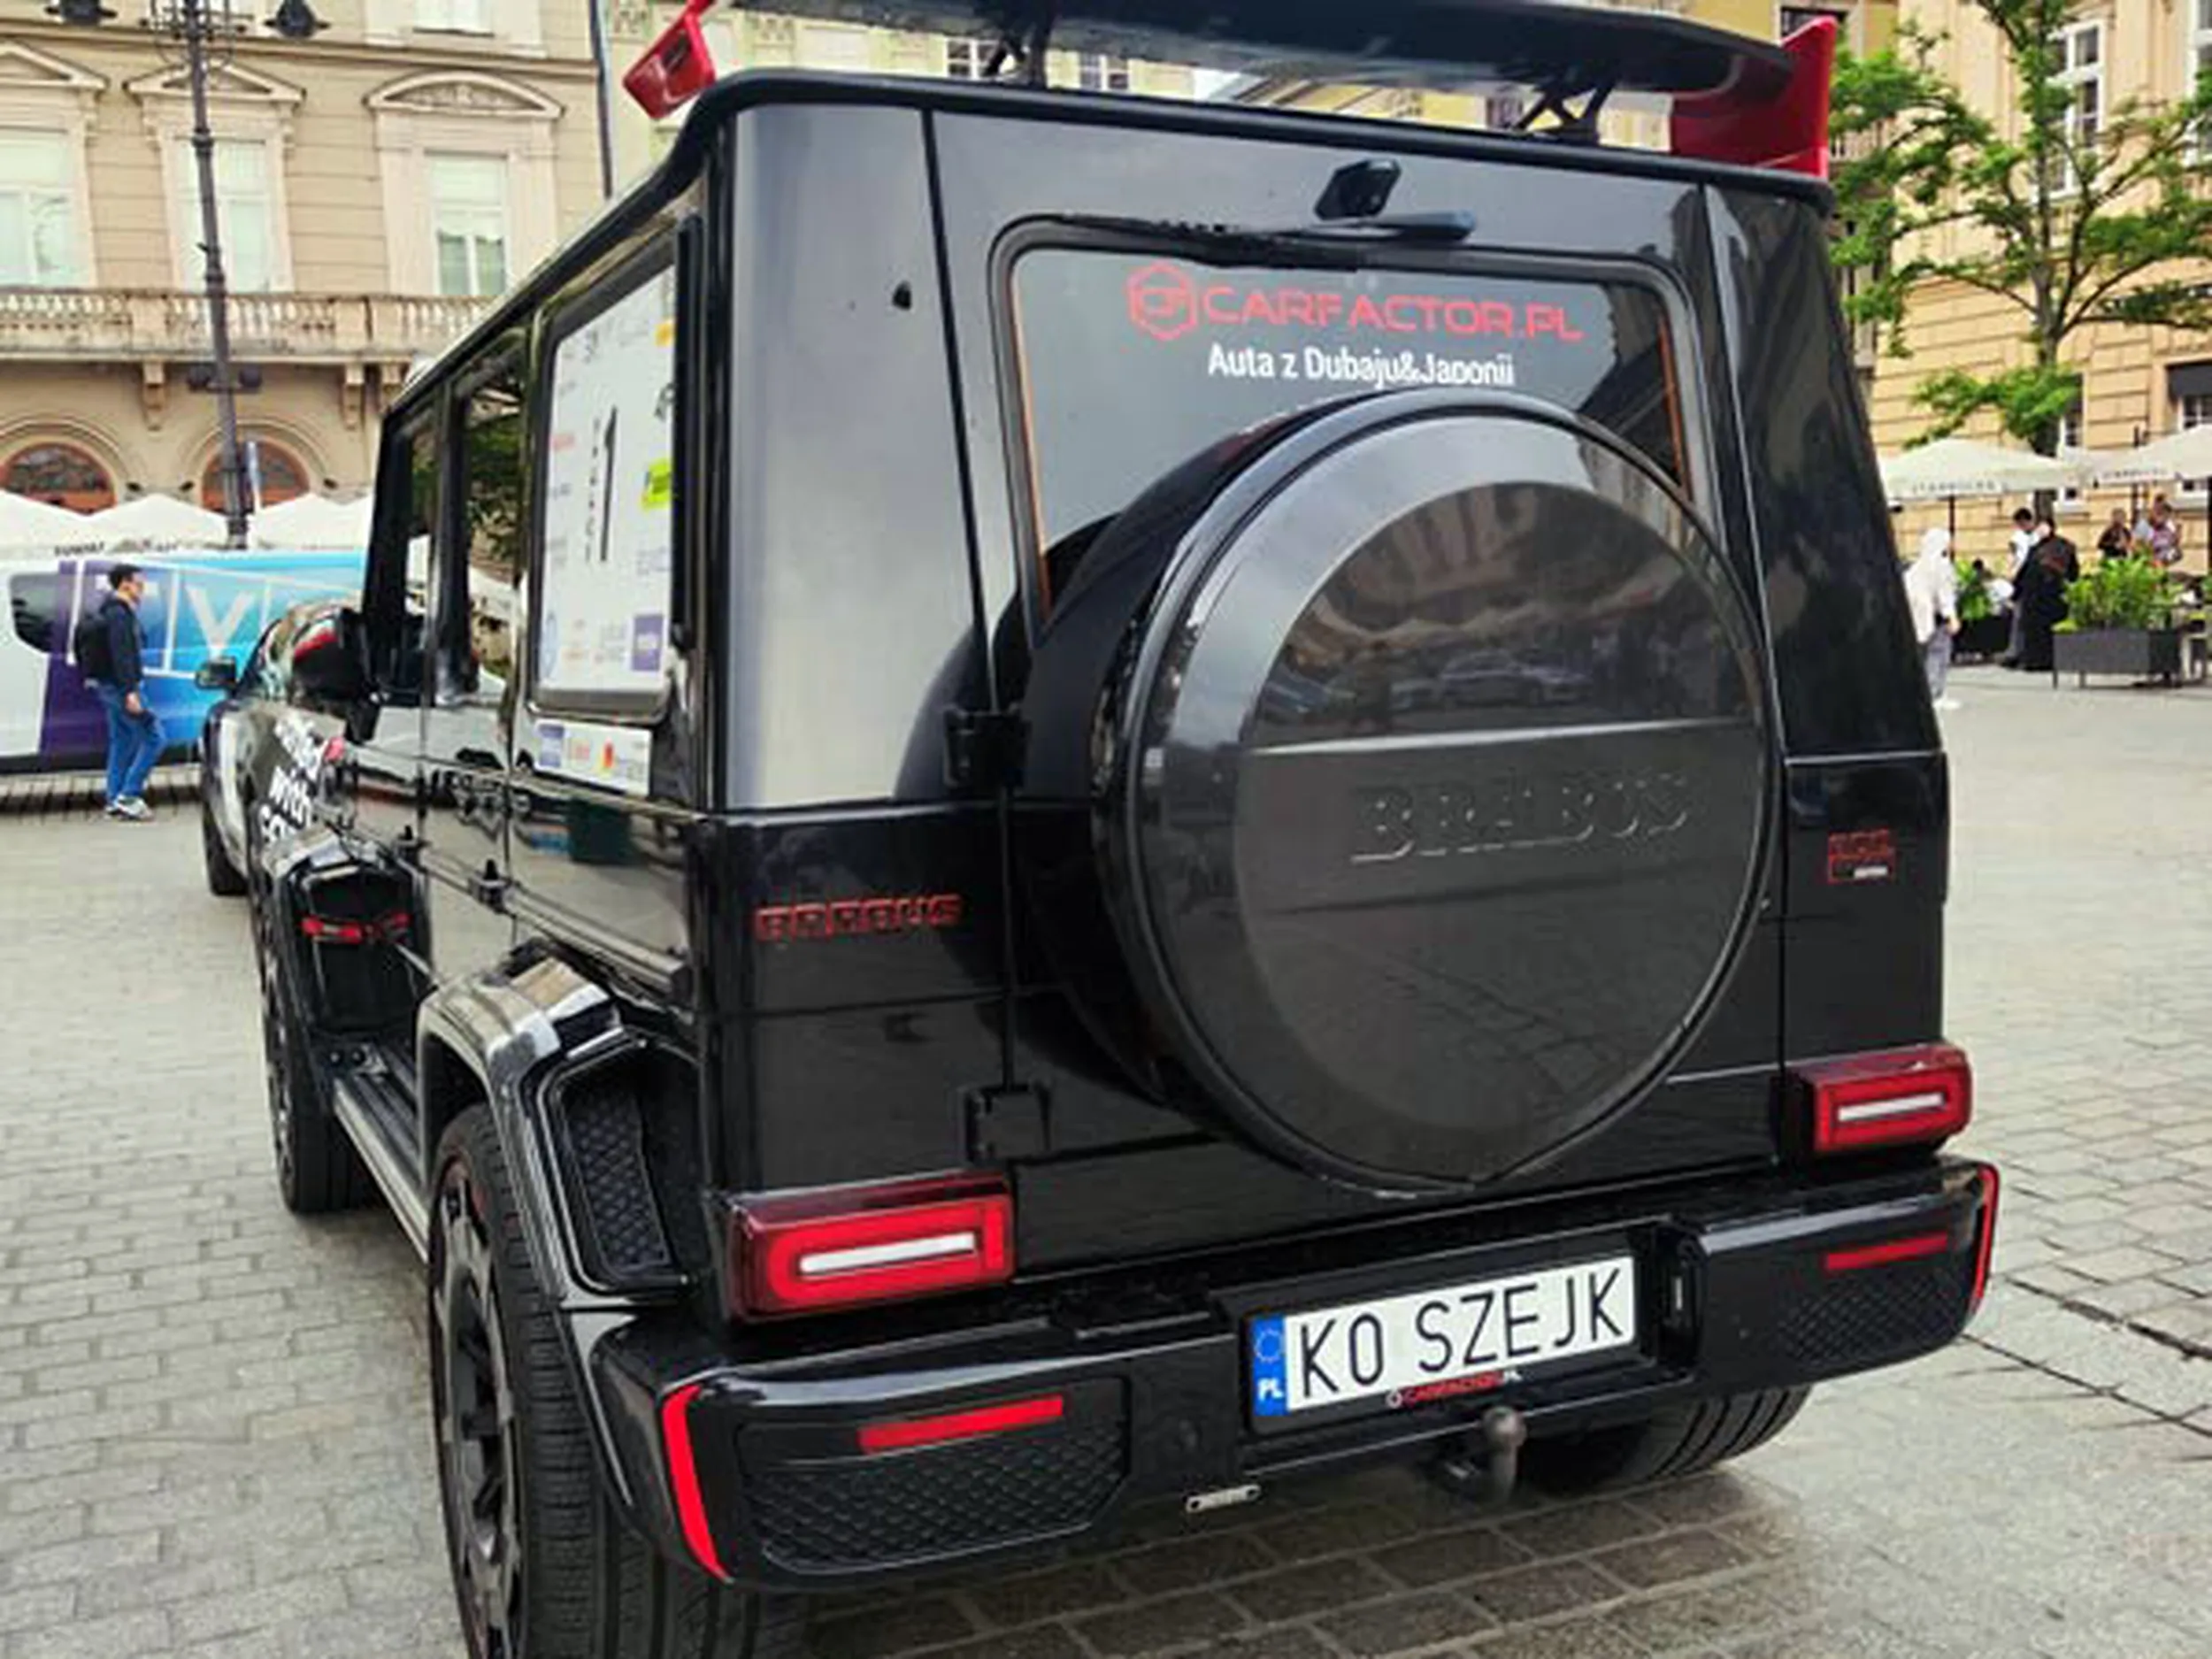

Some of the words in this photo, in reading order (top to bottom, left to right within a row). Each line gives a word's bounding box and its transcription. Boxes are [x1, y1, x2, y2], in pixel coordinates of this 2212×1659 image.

[1203, 286, 1584, 341] CARFACTOR.PL
[1209, 342, 1274, 378] Auta
[1282, 352, 1300, 379] z
[1415, 1268, 1623, 1372] SZEJK
[1257, 1377, 1284, 1402] PL
